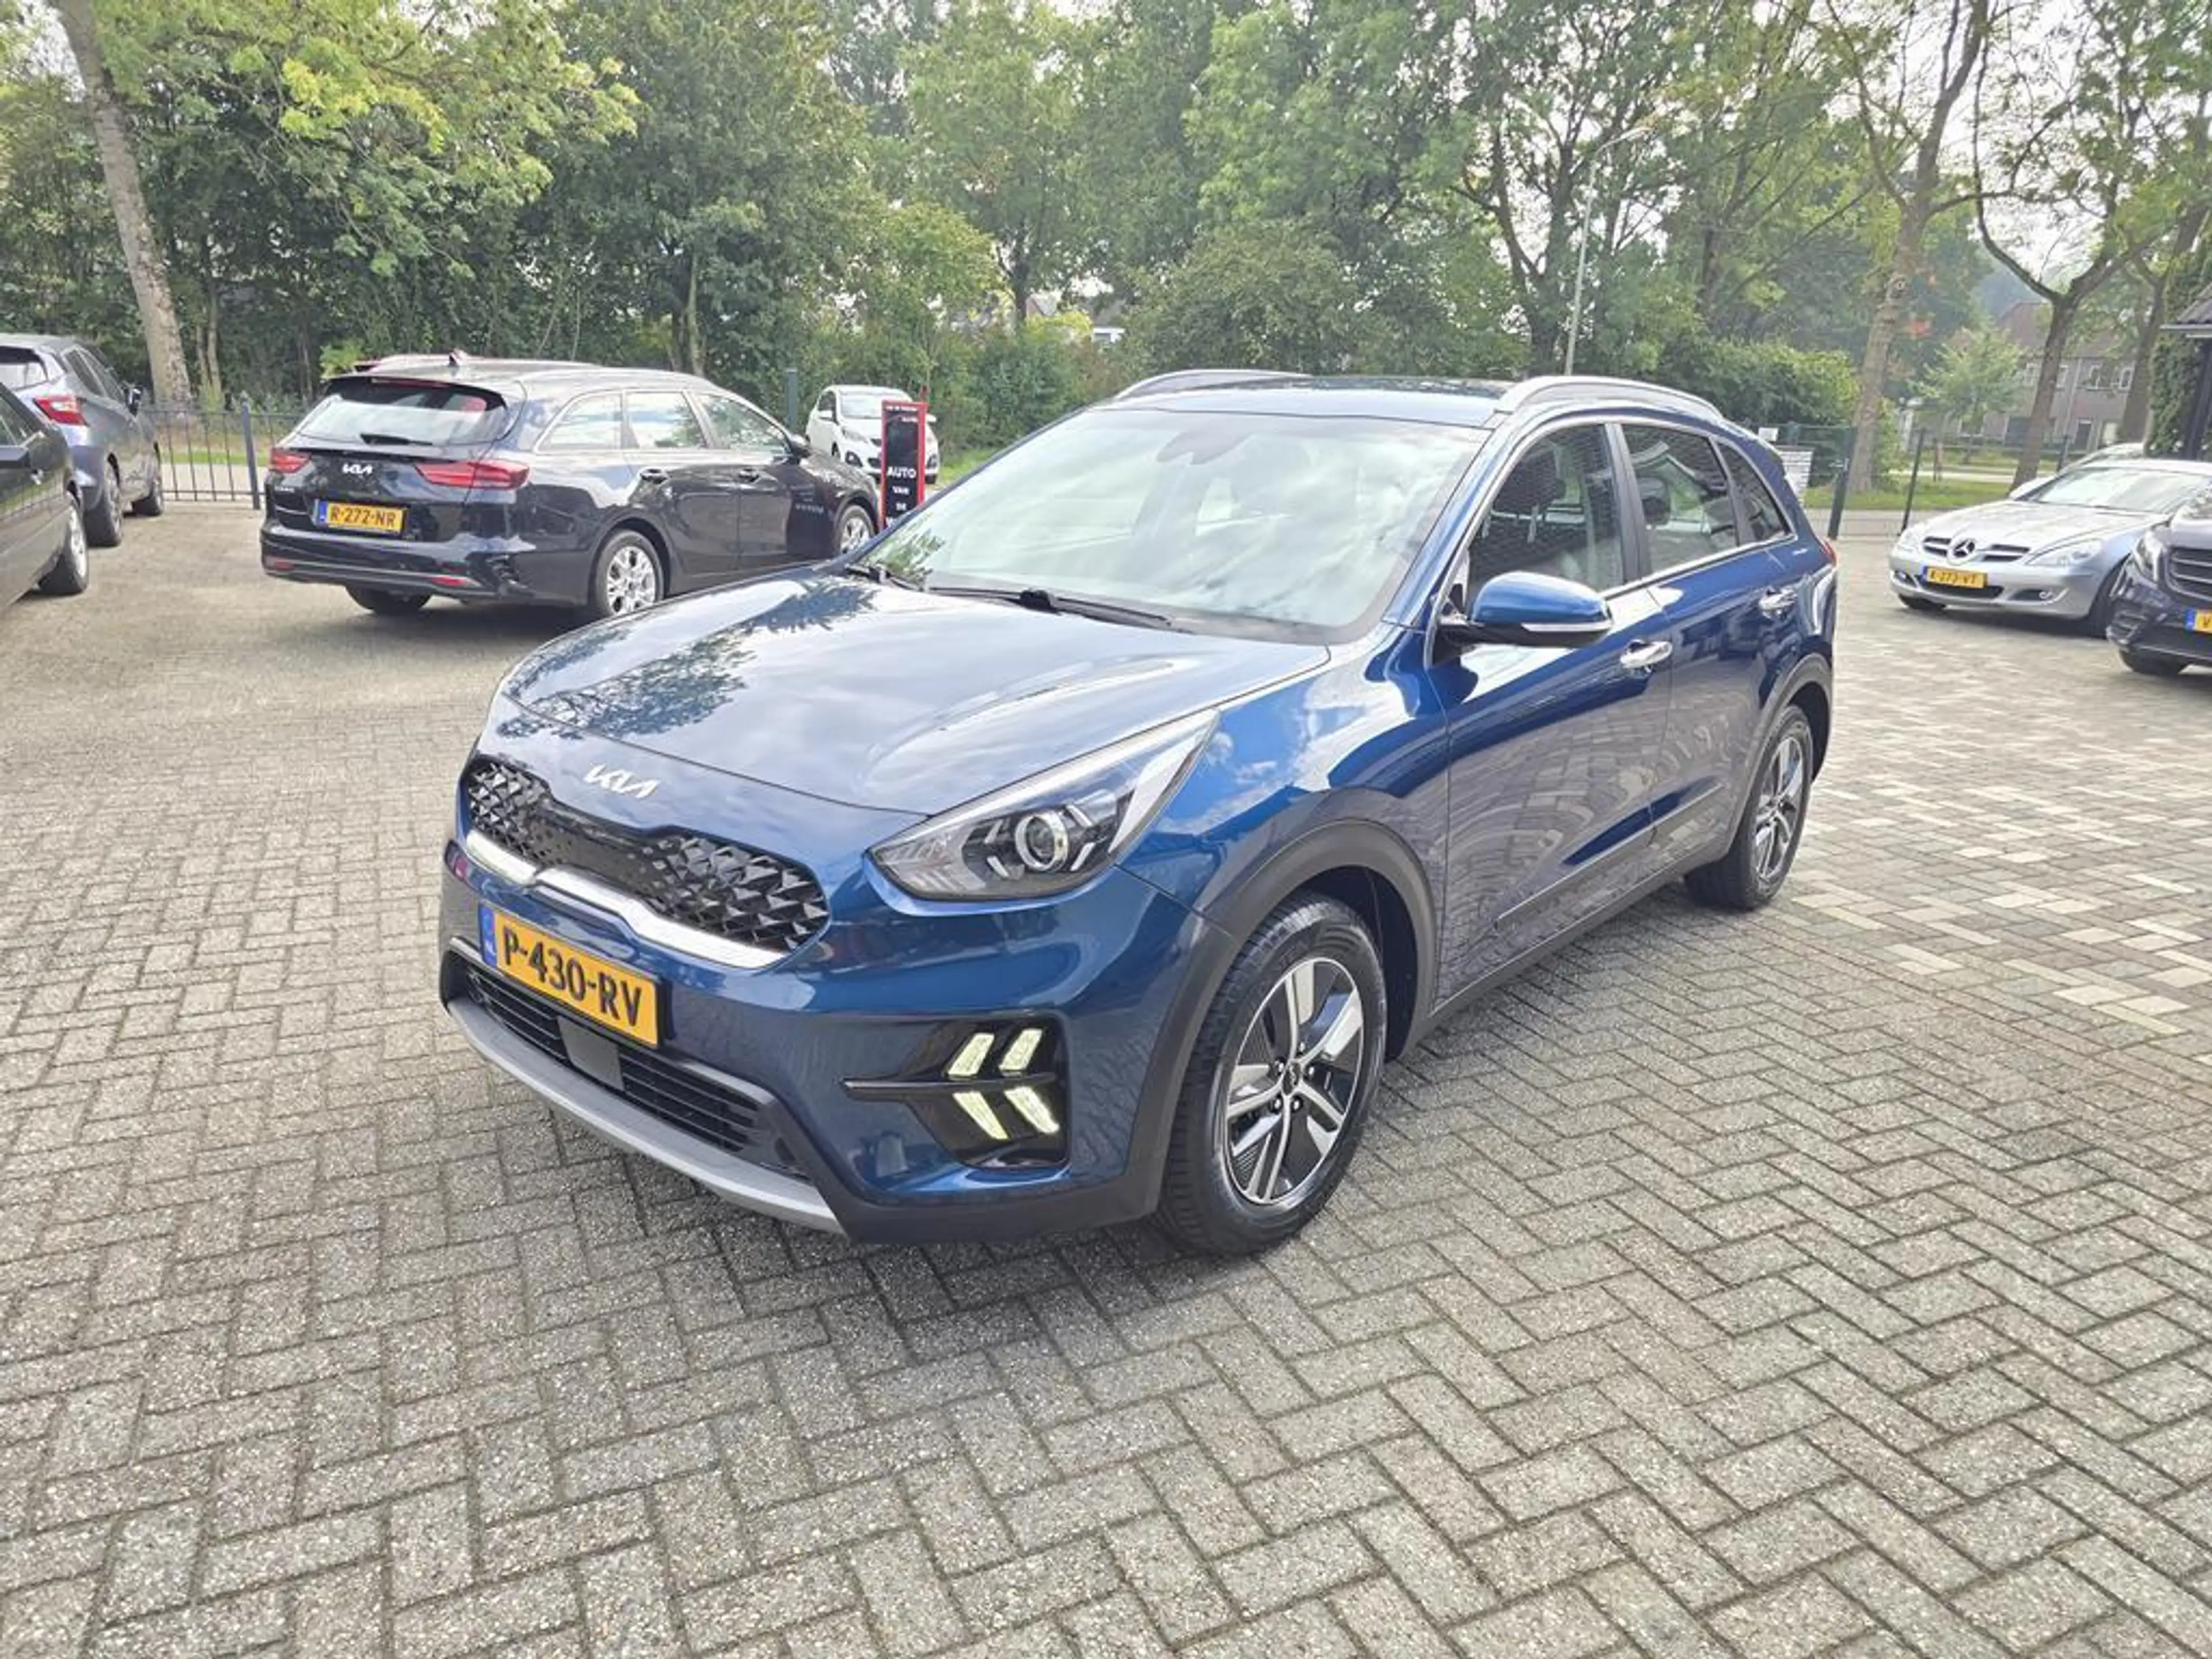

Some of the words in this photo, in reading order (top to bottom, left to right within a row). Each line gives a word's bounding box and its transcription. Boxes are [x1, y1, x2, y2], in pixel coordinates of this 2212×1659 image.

[887, 466, 917, 479] AUTO
[330, 505, 397, 528] R-272-NR
[582, 763, 661, 800] KIA
[502, 925, 643, 1028] P-430-RV
